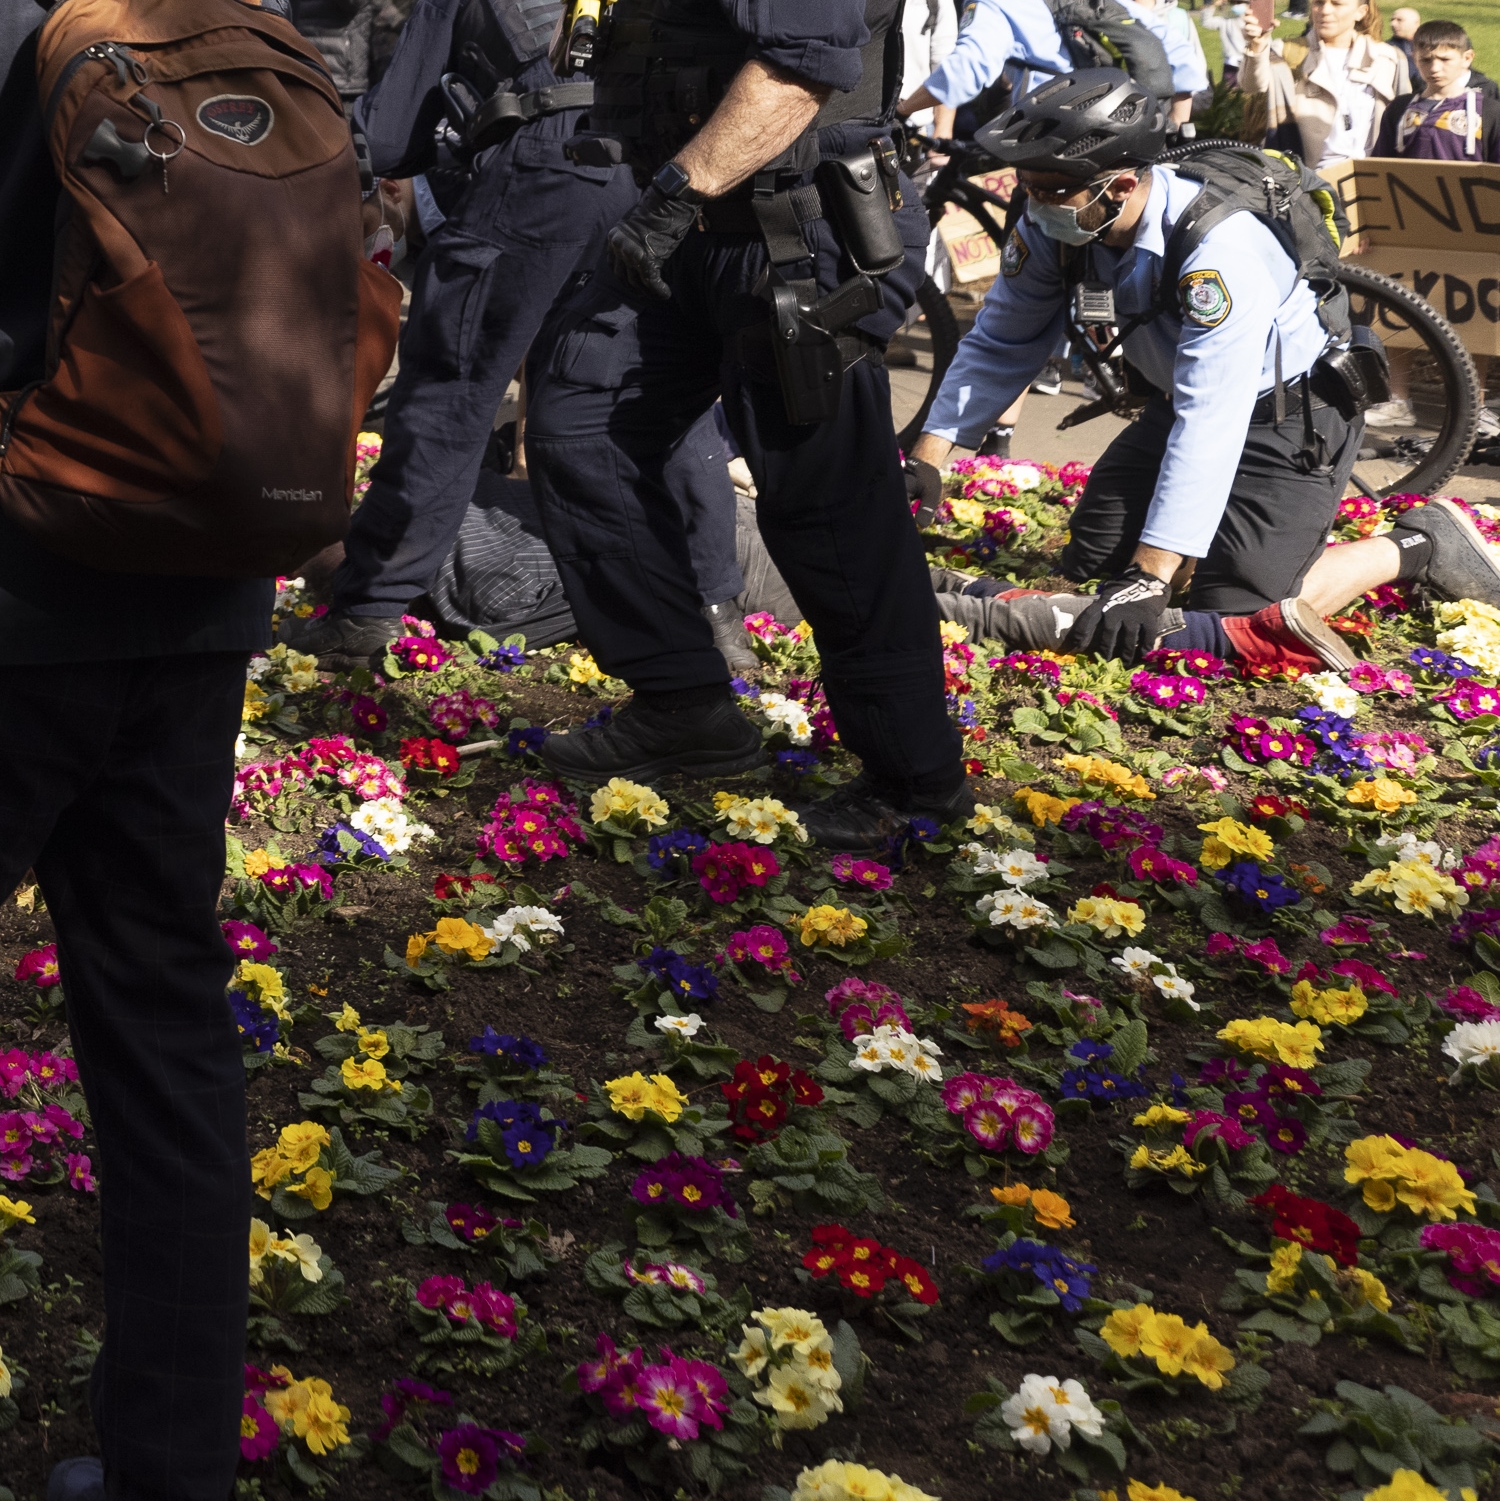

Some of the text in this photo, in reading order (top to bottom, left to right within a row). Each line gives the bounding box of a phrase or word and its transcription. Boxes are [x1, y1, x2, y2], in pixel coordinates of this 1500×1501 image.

[206, 101, 256, 117] OSPREY
[952, 235, 994, 264] NOT
[262, 486, 322, 501] Meridian
